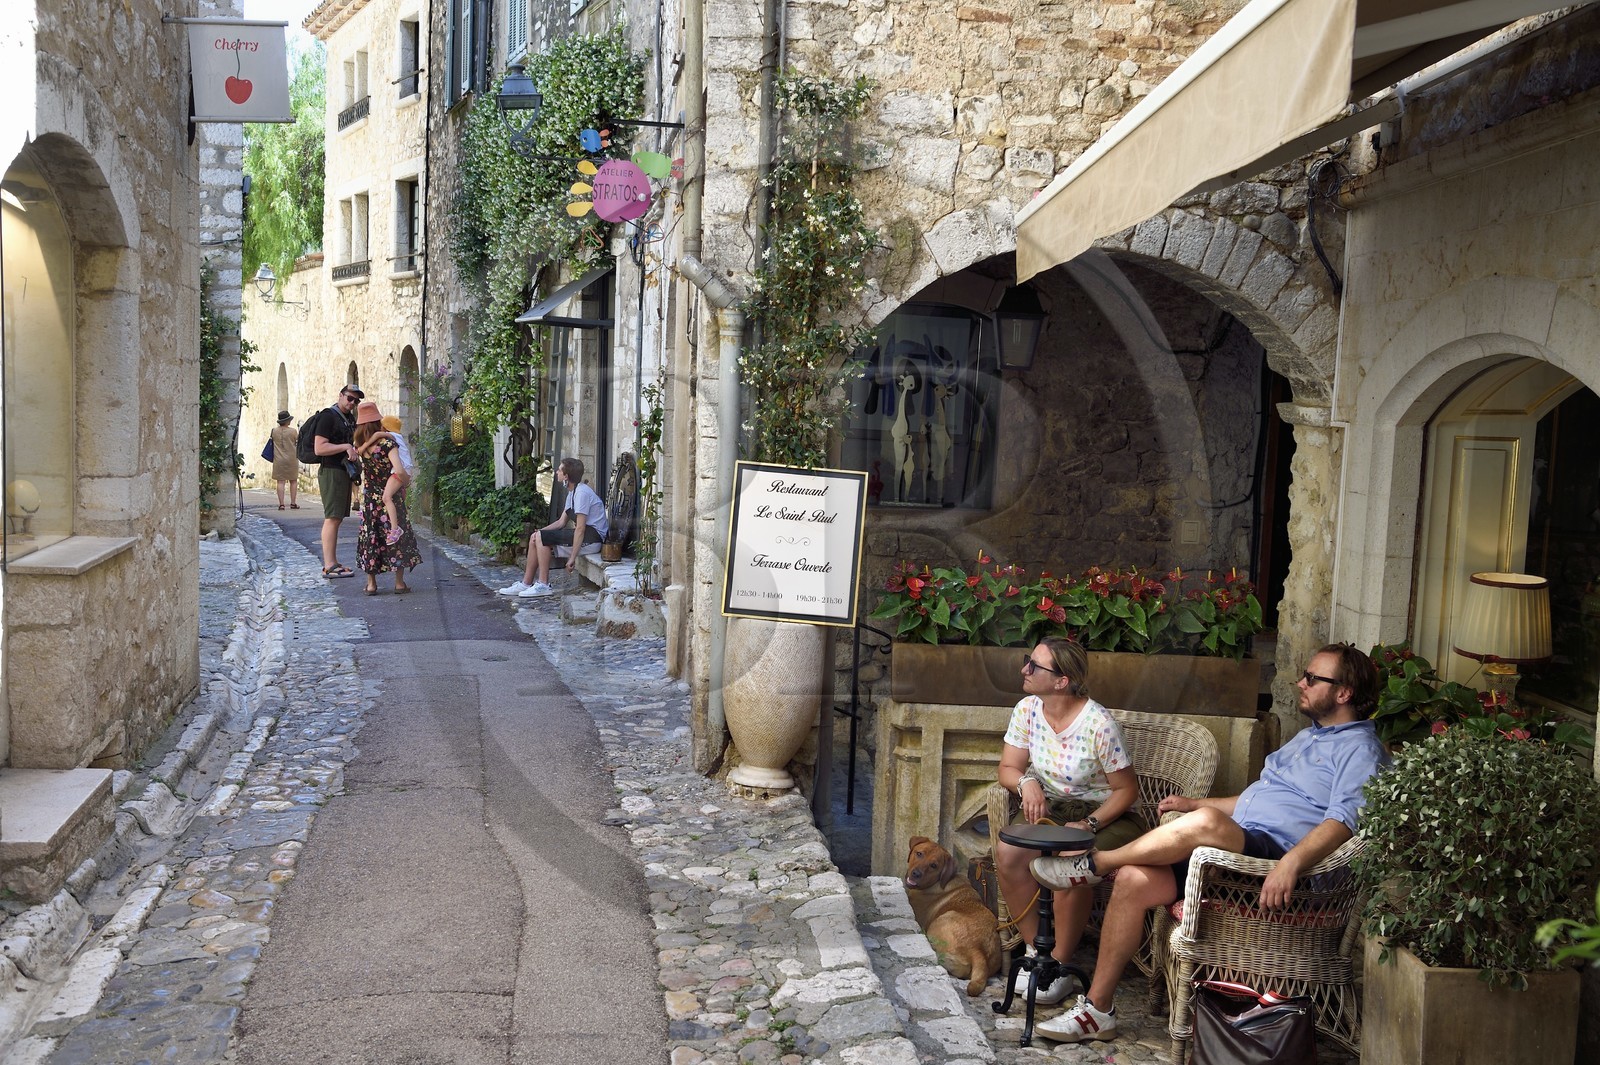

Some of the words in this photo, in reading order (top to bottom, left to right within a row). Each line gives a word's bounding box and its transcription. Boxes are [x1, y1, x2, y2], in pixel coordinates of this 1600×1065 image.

[215, 38, 258, 52] Cherry
[601, 169, 633, 178] ATELIER
[593, 183, 638, 202] STRATOS
[766, 479, 829, 497] Restaurant
[753, 505, 772, 519] Le
[774, 507, 806, 521] Saint
[807, 509, 838, 524] Paul
[750, 554, 792, 570] Terrasse
[794, 558, 832, 573] Ouverte
[762, 592, 783, 600] 14h00
[796, 595, 816, 603] 19h30
[821, 597, 843, 605] 21h30
